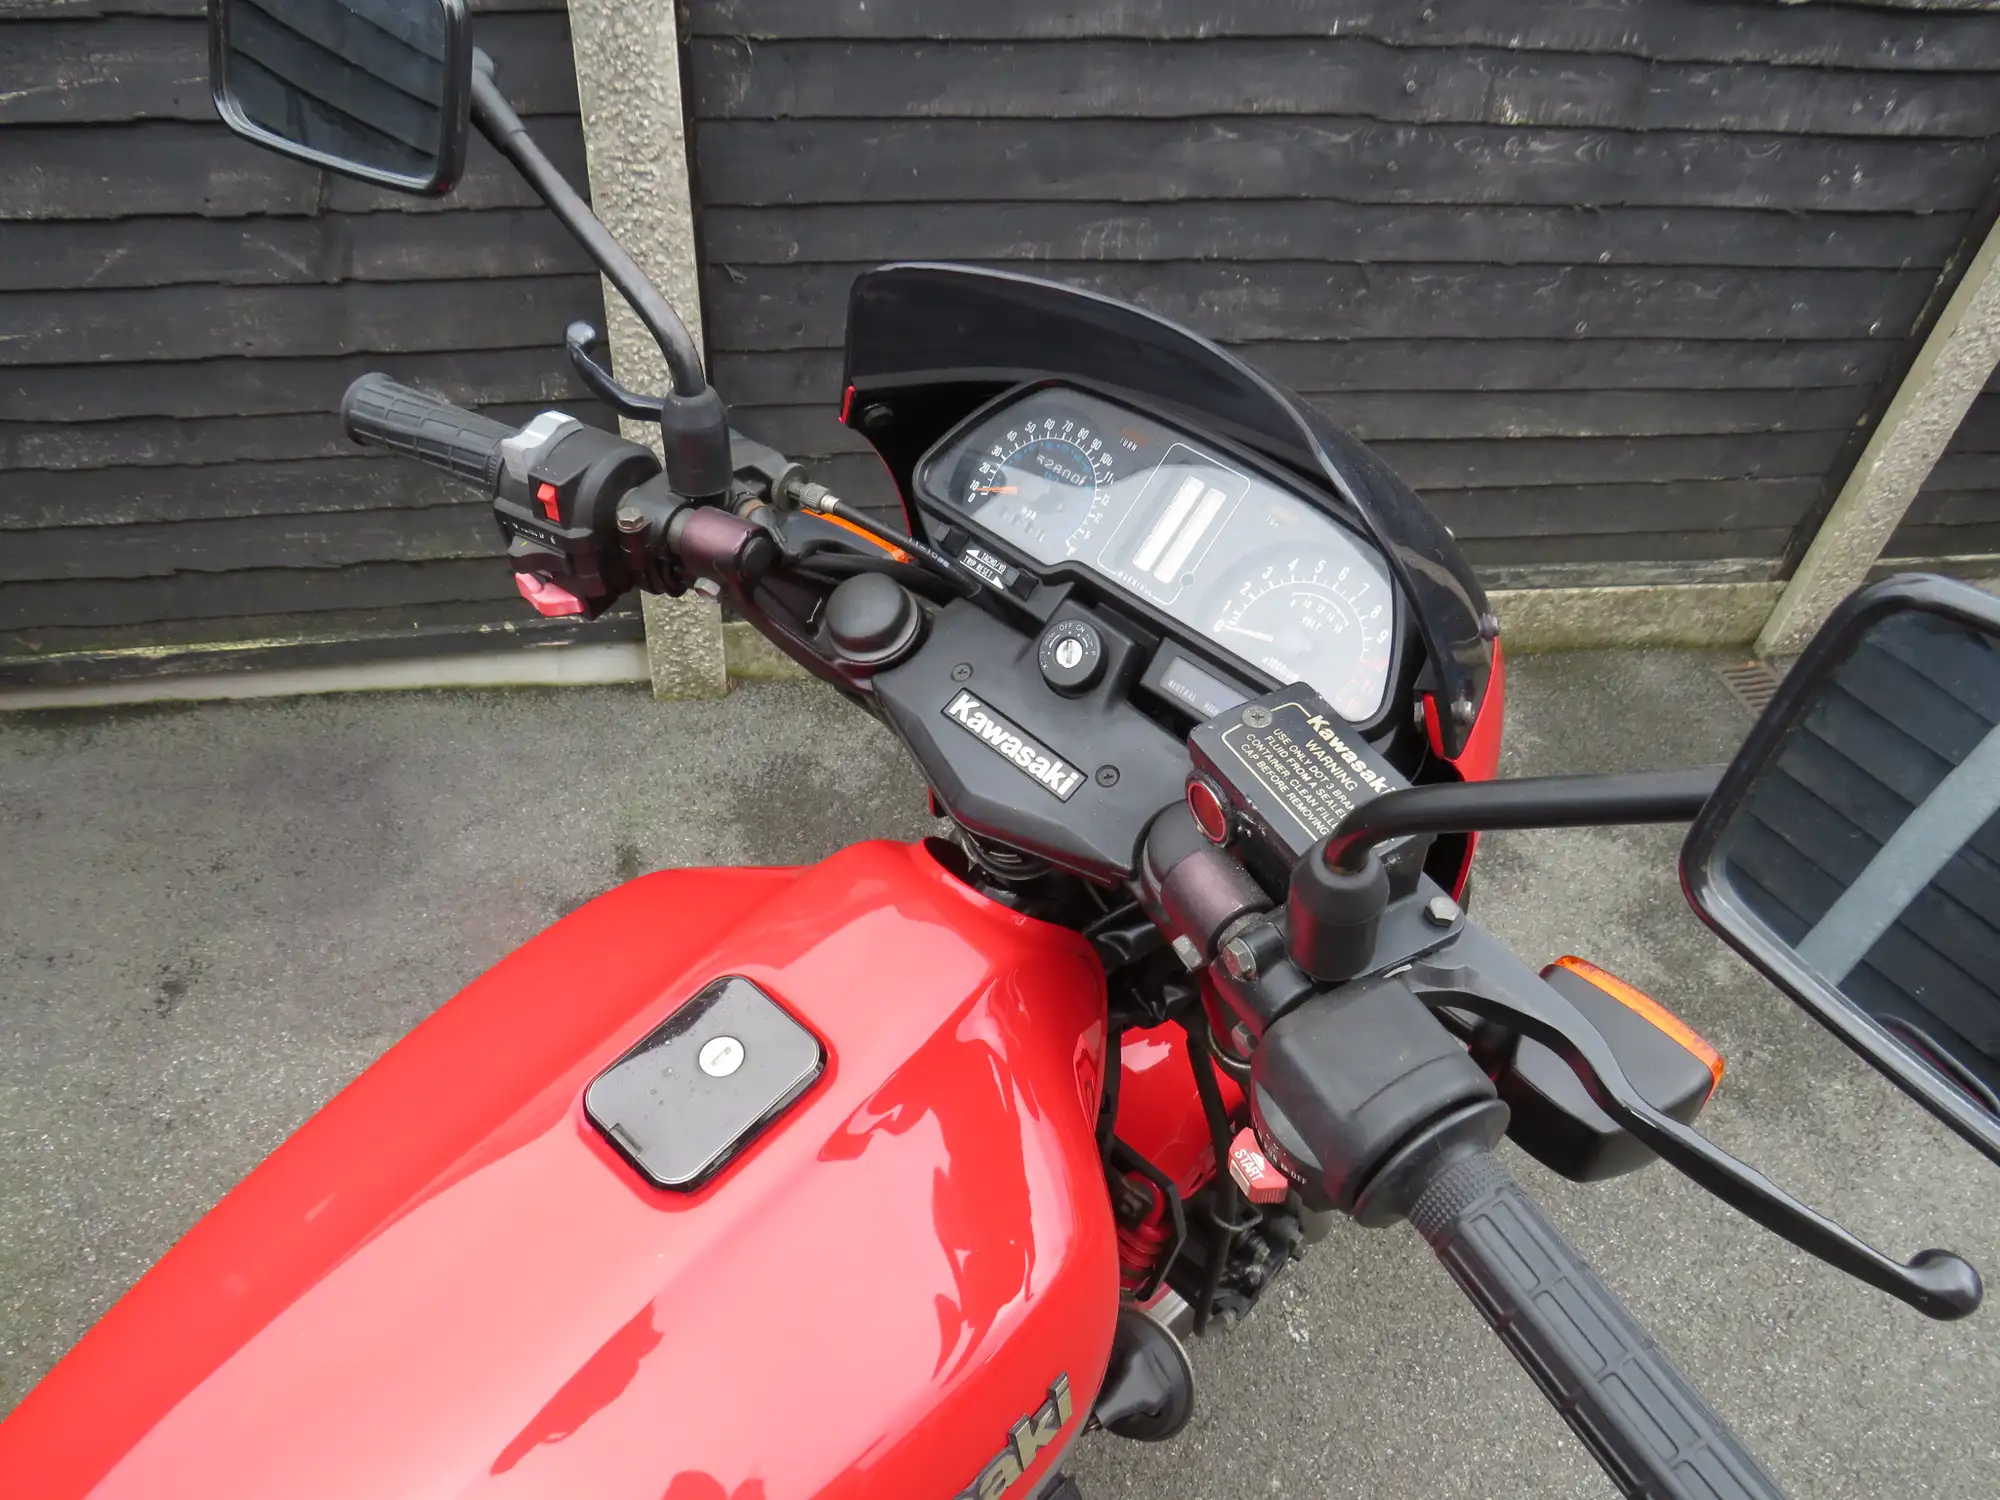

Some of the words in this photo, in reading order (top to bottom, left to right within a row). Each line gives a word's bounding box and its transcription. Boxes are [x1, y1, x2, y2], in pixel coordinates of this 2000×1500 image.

[1024, 421, 1036, 434] 50
[1044, 418, 1056, 430] 60
[1062, 420, 1074, 432] 70
[1006, 430, 1018, 442] 40
[1078, 428, 1090, 440] 80
[991, 446, 1002, 457] 30
[1090, 438, 1102, 450] 90
[1120, 436, 1138, 452] TURN
[1100, 452, 1113, 466] 100
[978, 462, 990, 474] 20
[969, 480, 980, 491] 10
[968, 492, 976, 503] 0
[963, 555, 976, 568] TRIP
[976, 563, 994, 578] RESET
[1288, 558, 1300, 572] 4
[1314, 558, 1326, 574] 5
[1262, 566, 1274, 580] 3
[1338, 566, 1350, 581] 6
[1240, 581, 1252, 596] 2
[1358, 582, 1370, 597] 7
[1222, 600, 1232, 613] 1
[1370, 604, 1382, 619] 8
[1213, 619, 1225, 632] 0
[1376, 630, 1389, 644] 9
[1168, 680, 1196, 702] NEUTRAL
[948, 694, 1080, 796] Kawasaki
[1264, 735, 1288, 758] FLUID
[1286, 758, 1312, 782] FROM
[1273, 728, 1292, 746] USE
[1289, 745, 1312, 765] ONLY
[1309, 766, 1330, 782] DOT
[1306, 714, 1396, 794] Kawasaki
[1246, 734, 1290, 780] CONTAINER.
[1290, 778, 1320, 807] CLEAN
[1305, 739, 1358, 792] WARNING
[1241, 744, 1260, 760] CAP
[1256, 760, 1290, 793] BEFORE
[1286, 792, 1330, 836] REMOVING
[1234, 1148, 1264, 1181] START
[962, 1371, 1072, 1500] aki
